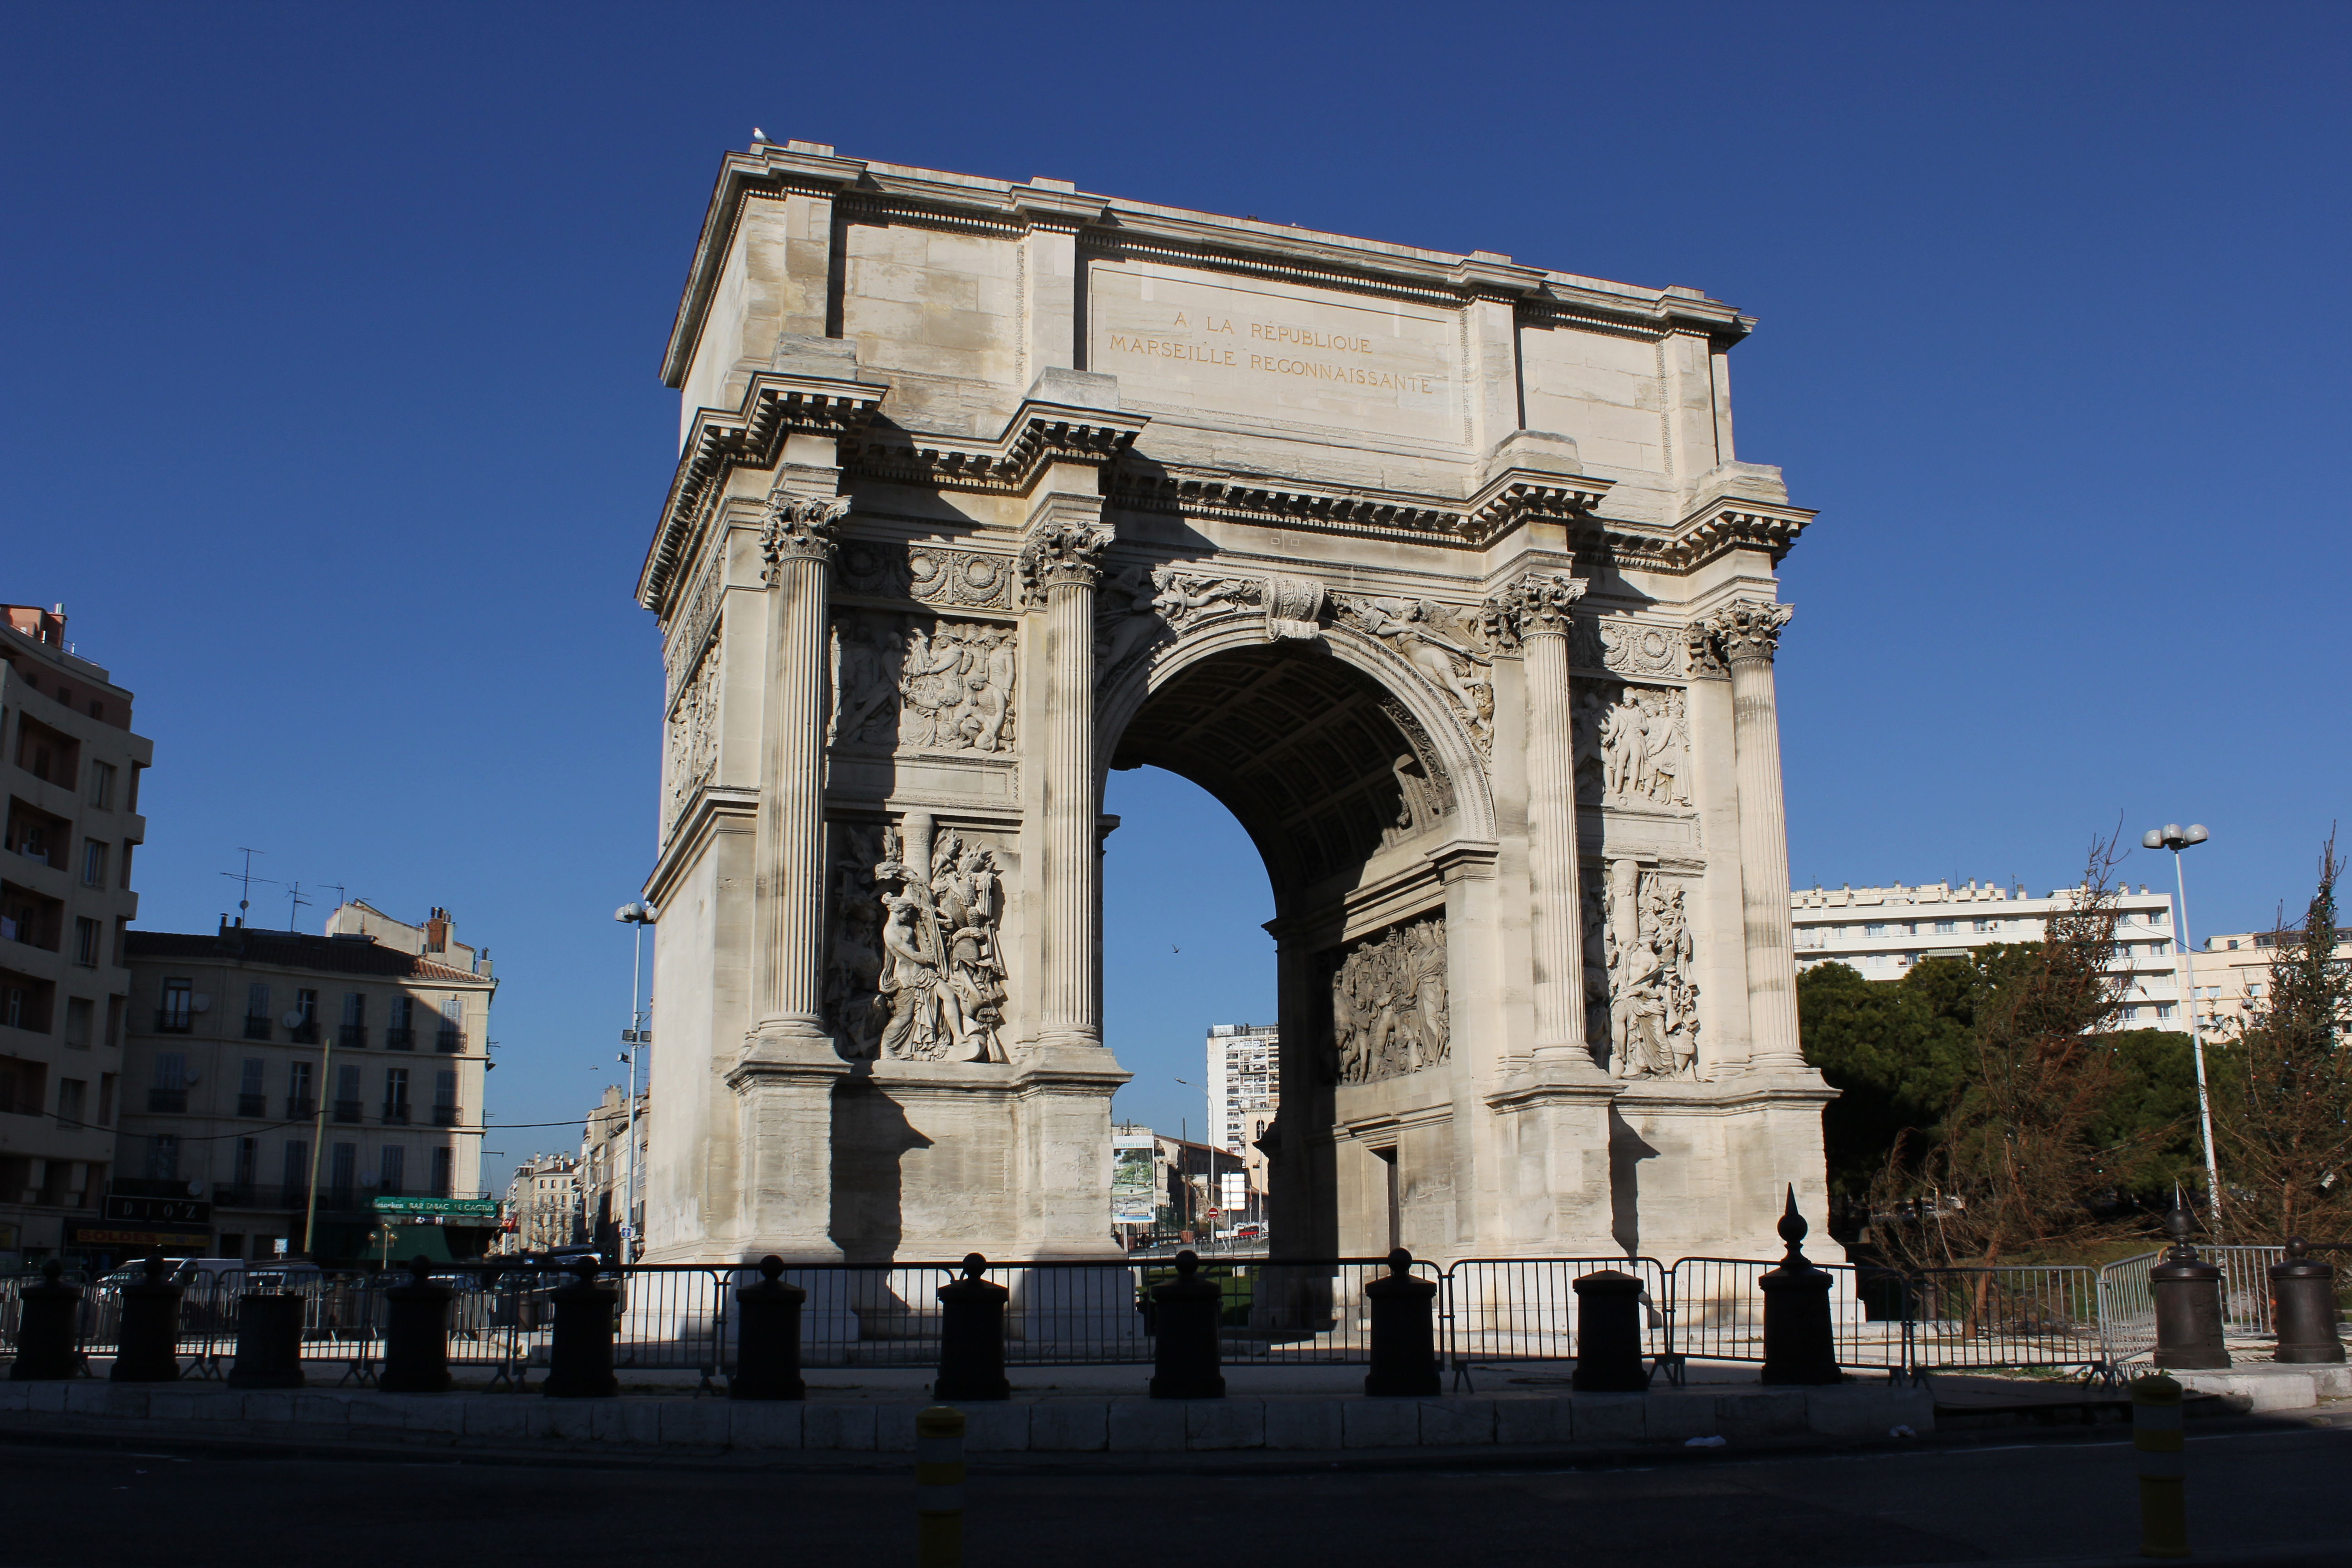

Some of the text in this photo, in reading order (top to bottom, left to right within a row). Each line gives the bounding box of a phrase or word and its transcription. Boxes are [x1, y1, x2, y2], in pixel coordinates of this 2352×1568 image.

[1174, 312, 1373, 353] A LA RÉPUBLIQUE
[1109, 334, 1434, 395] MARSEILLE RECONNAISSANTE
[79, 1230, 157, 1243] SOLDES
